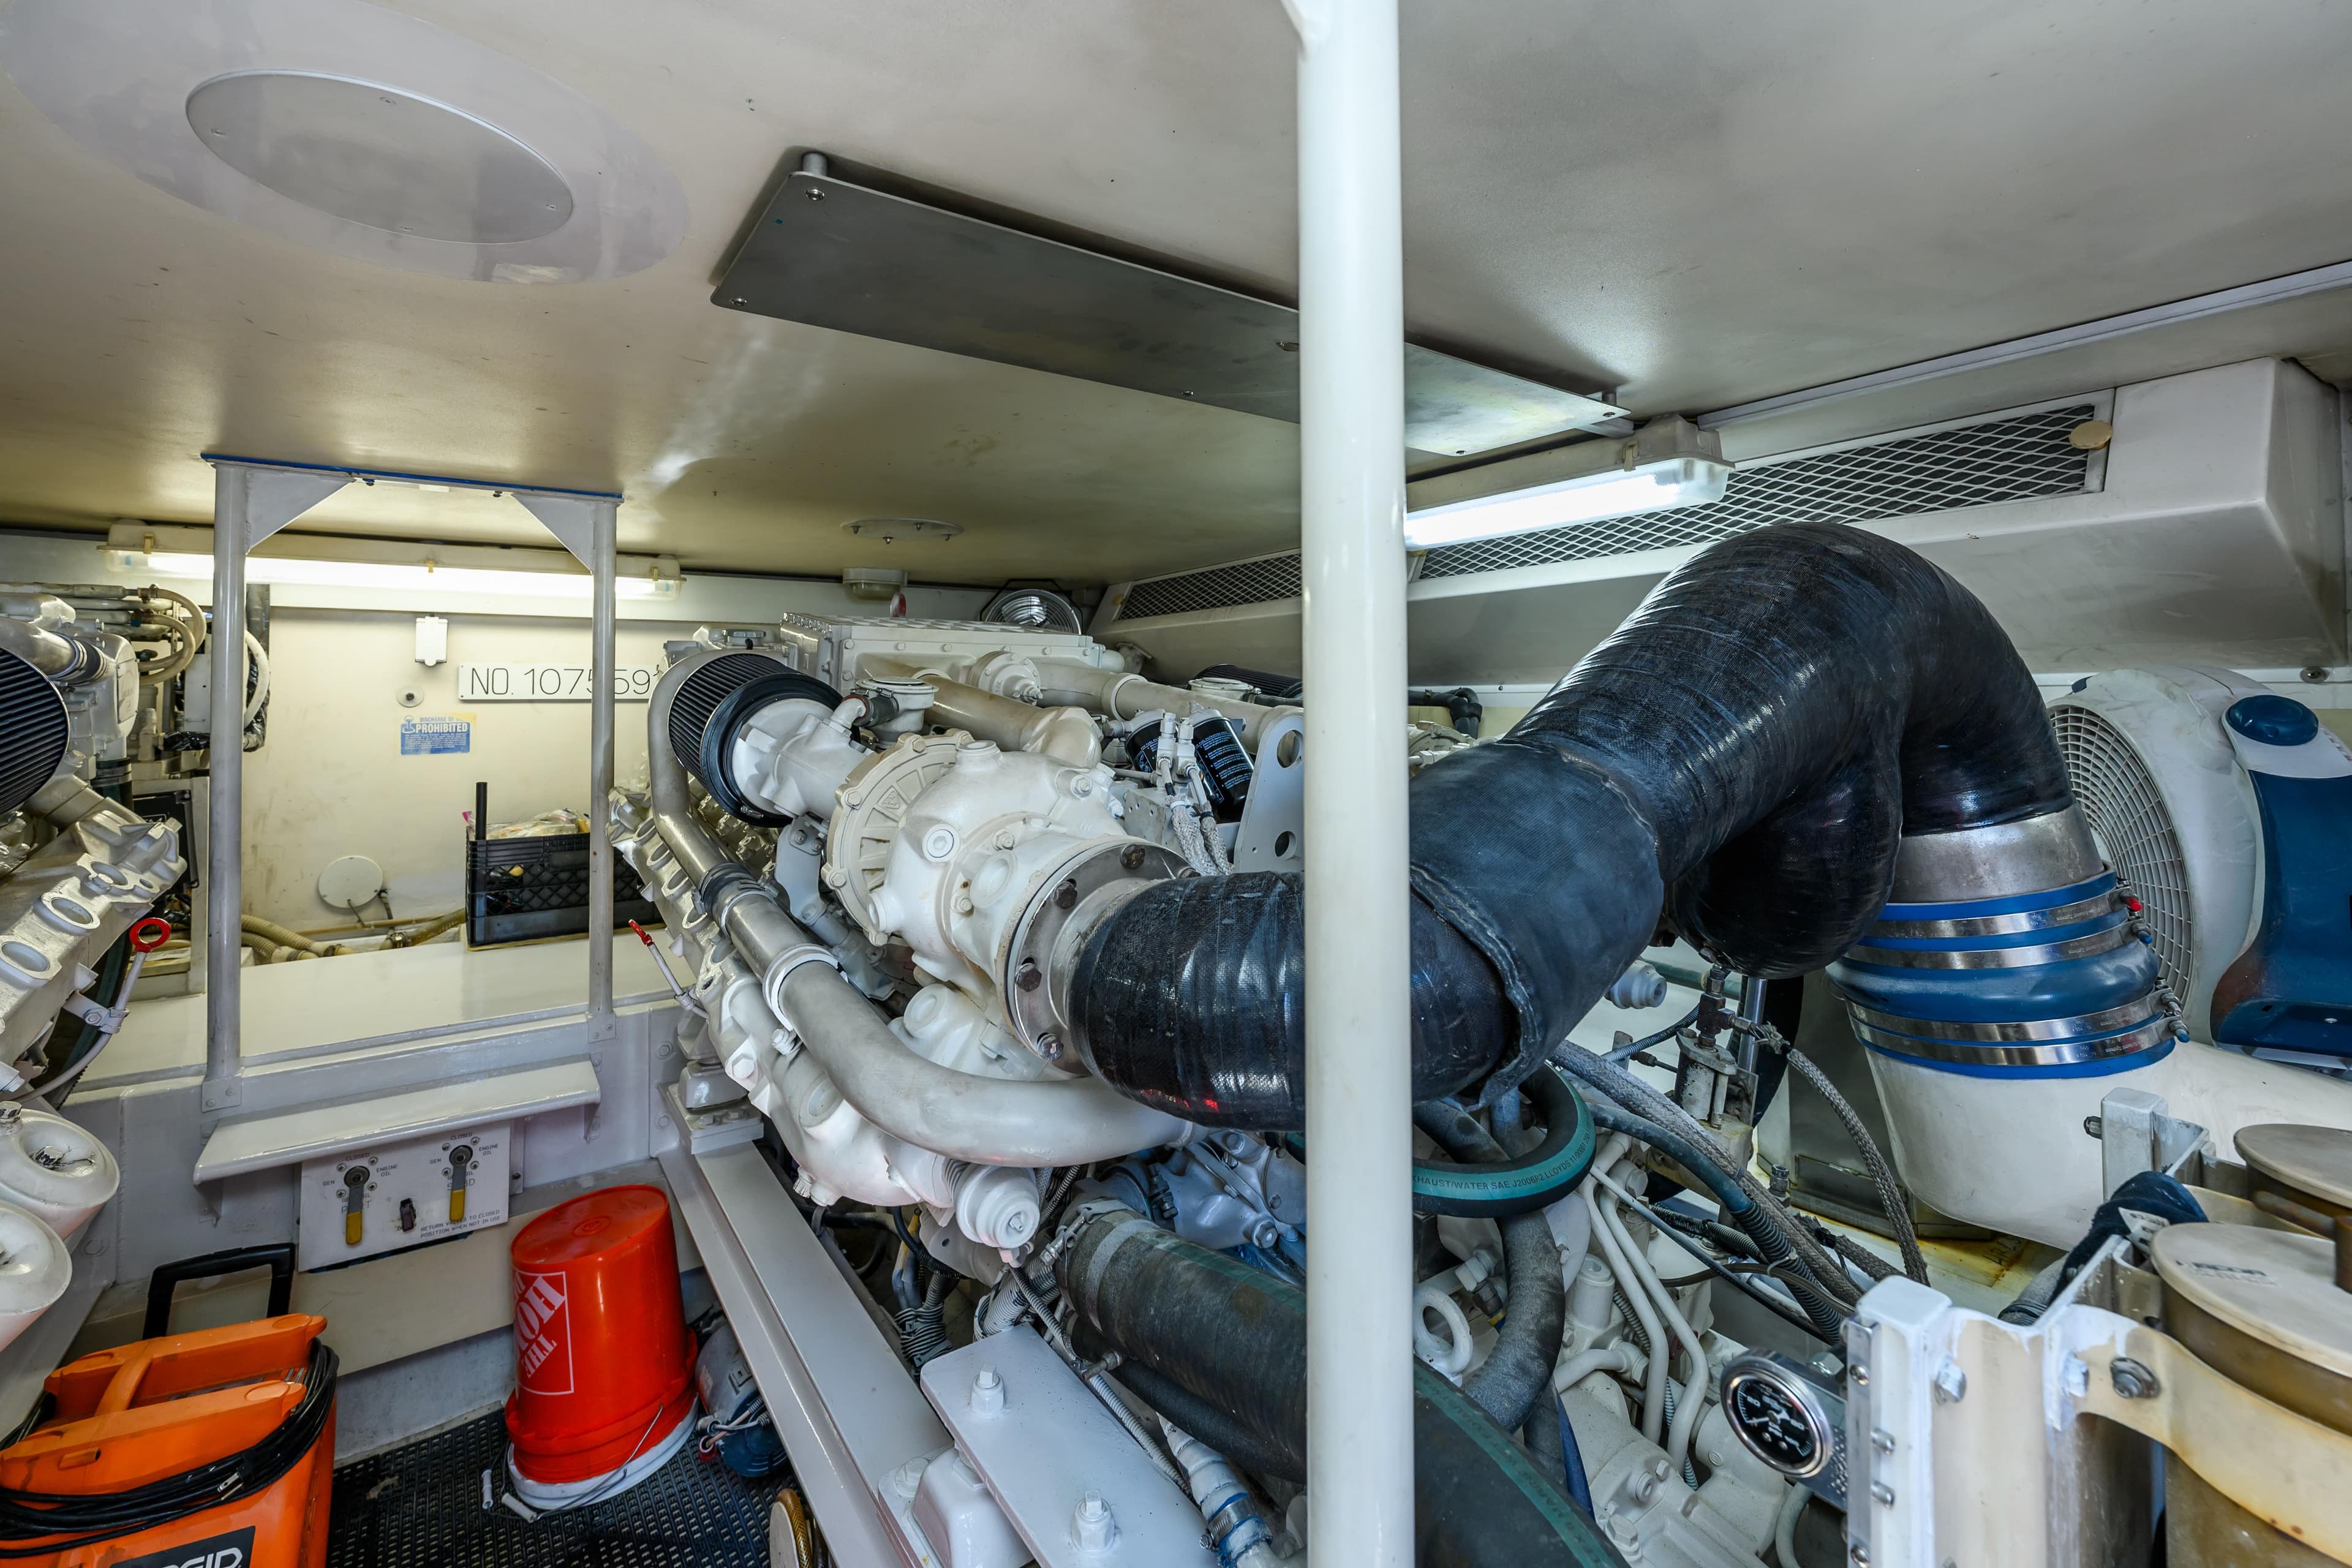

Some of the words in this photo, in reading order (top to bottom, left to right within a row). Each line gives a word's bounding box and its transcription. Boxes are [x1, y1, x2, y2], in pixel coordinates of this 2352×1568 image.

[471, 668, 514, 695] NO.
[523, 668, 658, 695] 10759
[415, 723, 467, 734] PROHIBITED
[345, 1152, 369, 1161] CLOSED
[376, 1164, 398, 1172] ENGINE
[1412, 1175, 1488, 1189] XHAUST/WATER
[1545, 1159, 1572, 1180] LLOYDS
[421, 1223, 444, 1231] RETURN
[478, 1210, 500, 1219] CLOSED
[421, 1227, 450, 1238] POSITION
[522, 1333, 558, 1379] THE
